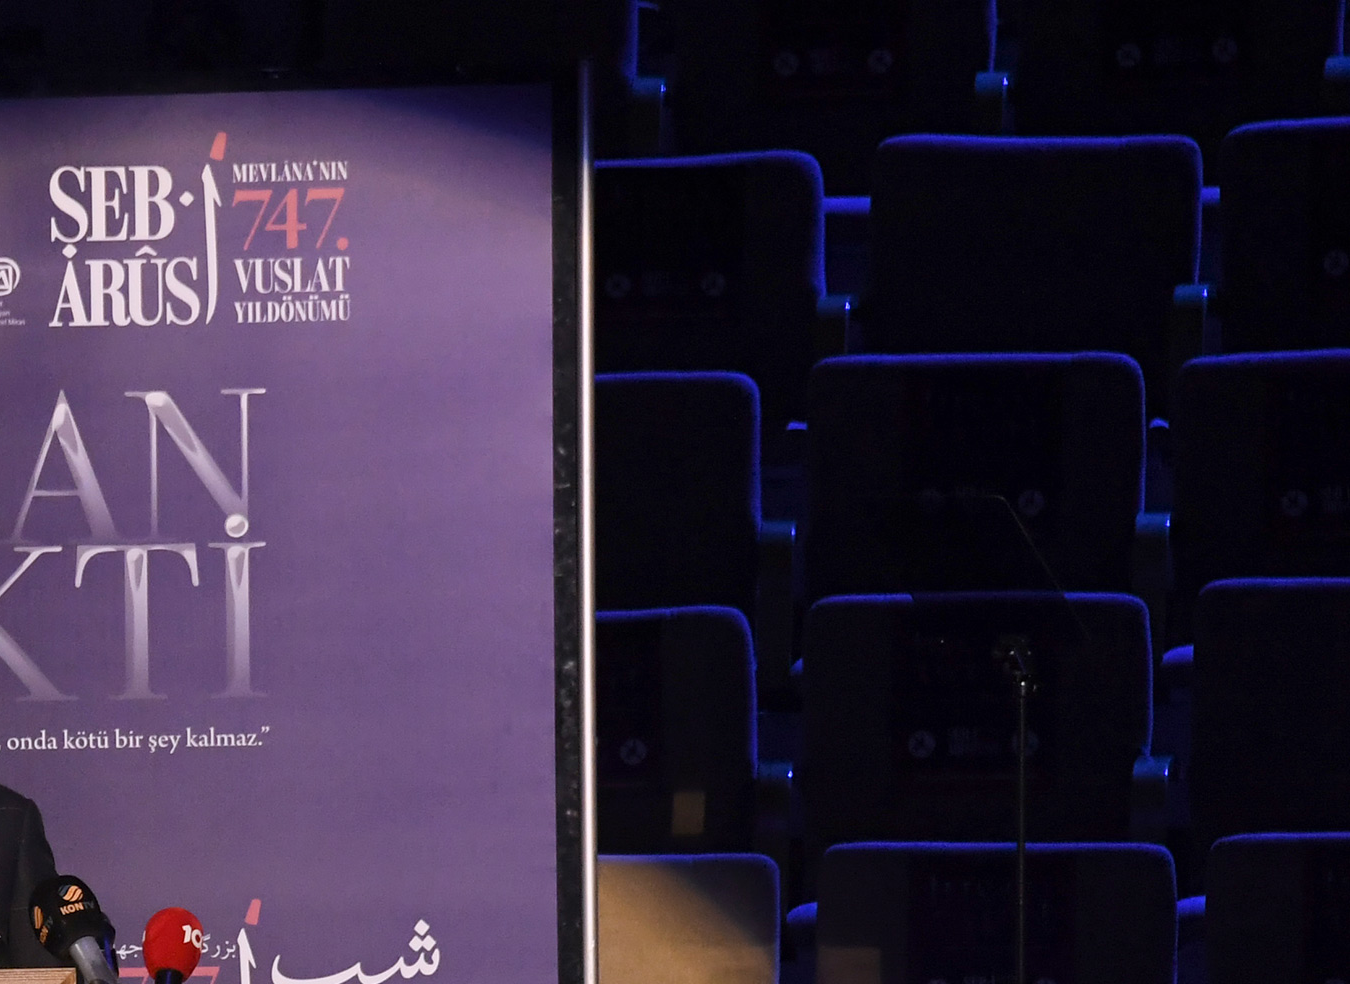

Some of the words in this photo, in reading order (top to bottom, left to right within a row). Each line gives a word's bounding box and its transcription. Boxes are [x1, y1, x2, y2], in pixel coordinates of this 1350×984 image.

[232, 187, 349, 251] 747.
[233, 256, 350, 294] VUSLAT
[234, 294, 351, 323] YILDÖNÜMÜ
[7, 730, 58, 750] onda
[62, 729, 110, 750] kötü
[114, 728, 144, 749] bir
[148, 734, 181, 754] şey
